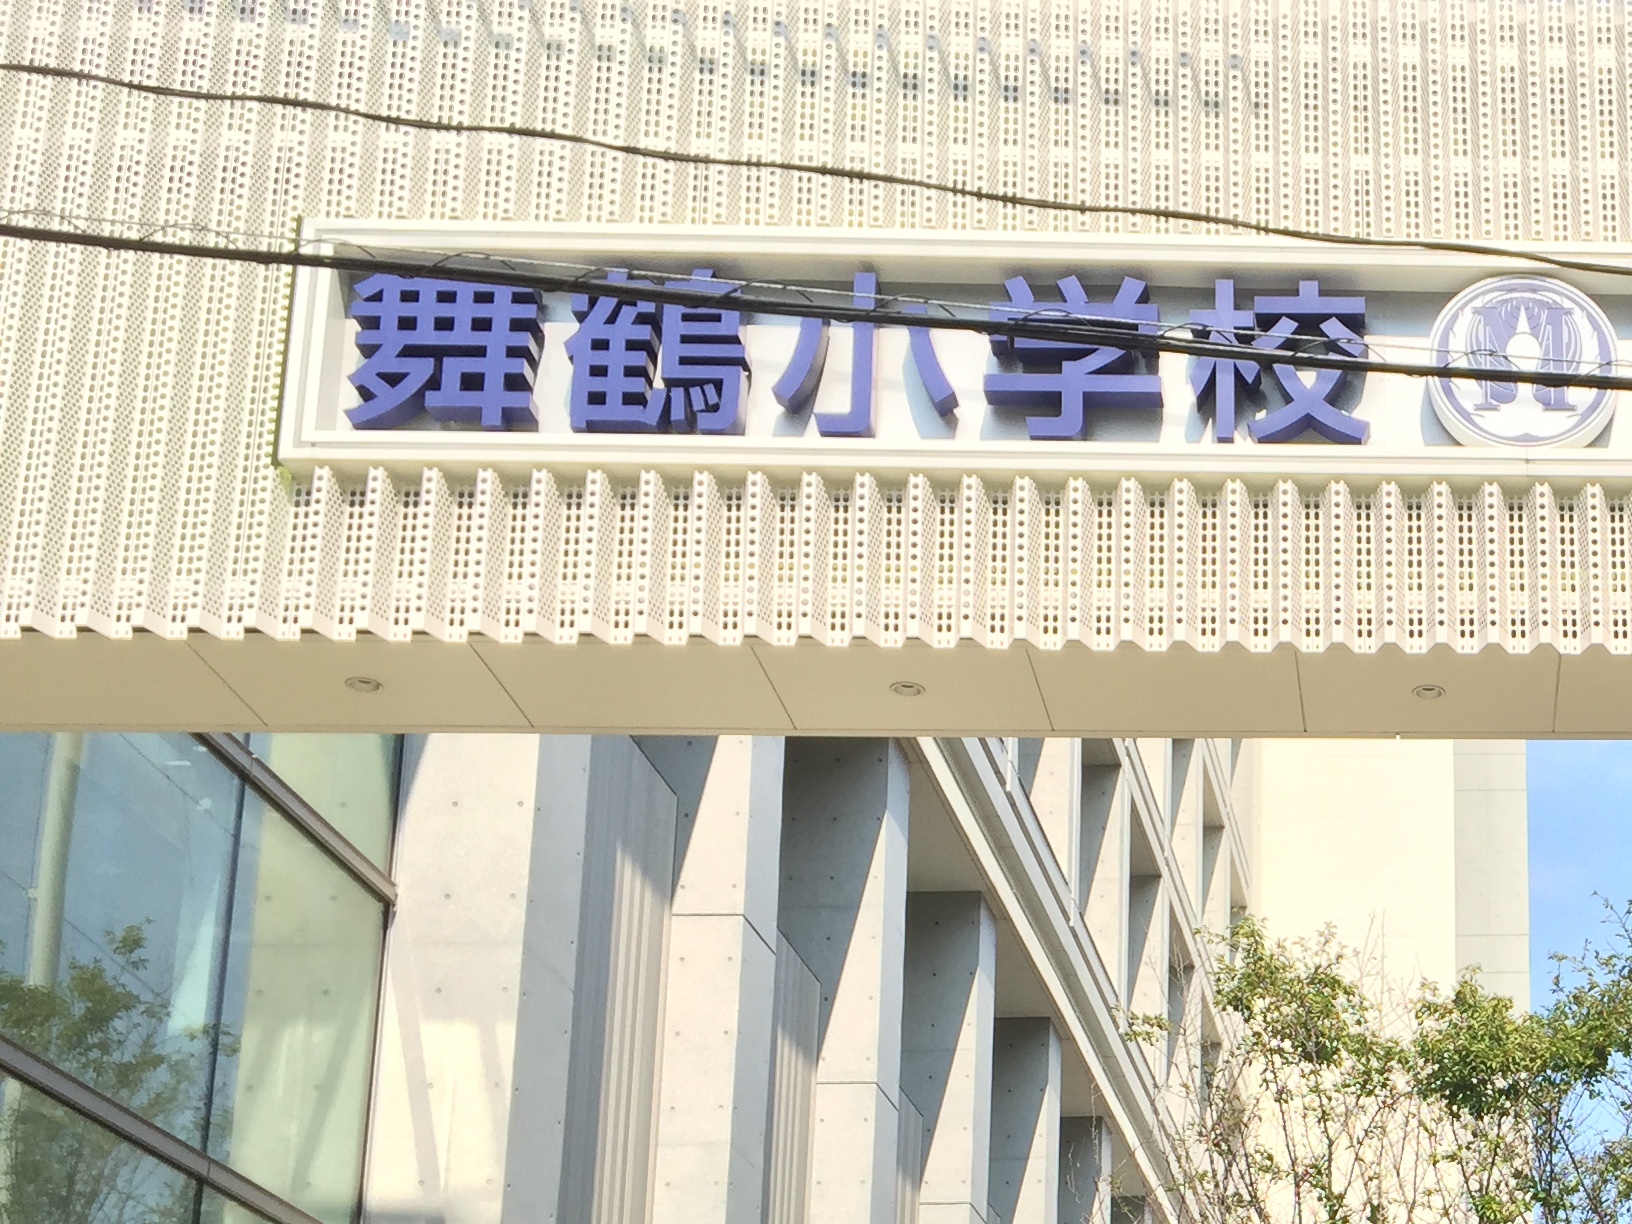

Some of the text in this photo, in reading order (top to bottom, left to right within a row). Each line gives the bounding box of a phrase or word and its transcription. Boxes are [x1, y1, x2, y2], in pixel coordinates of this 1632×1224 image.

[345, 268, 1370, 445] 舞鶴小学校
